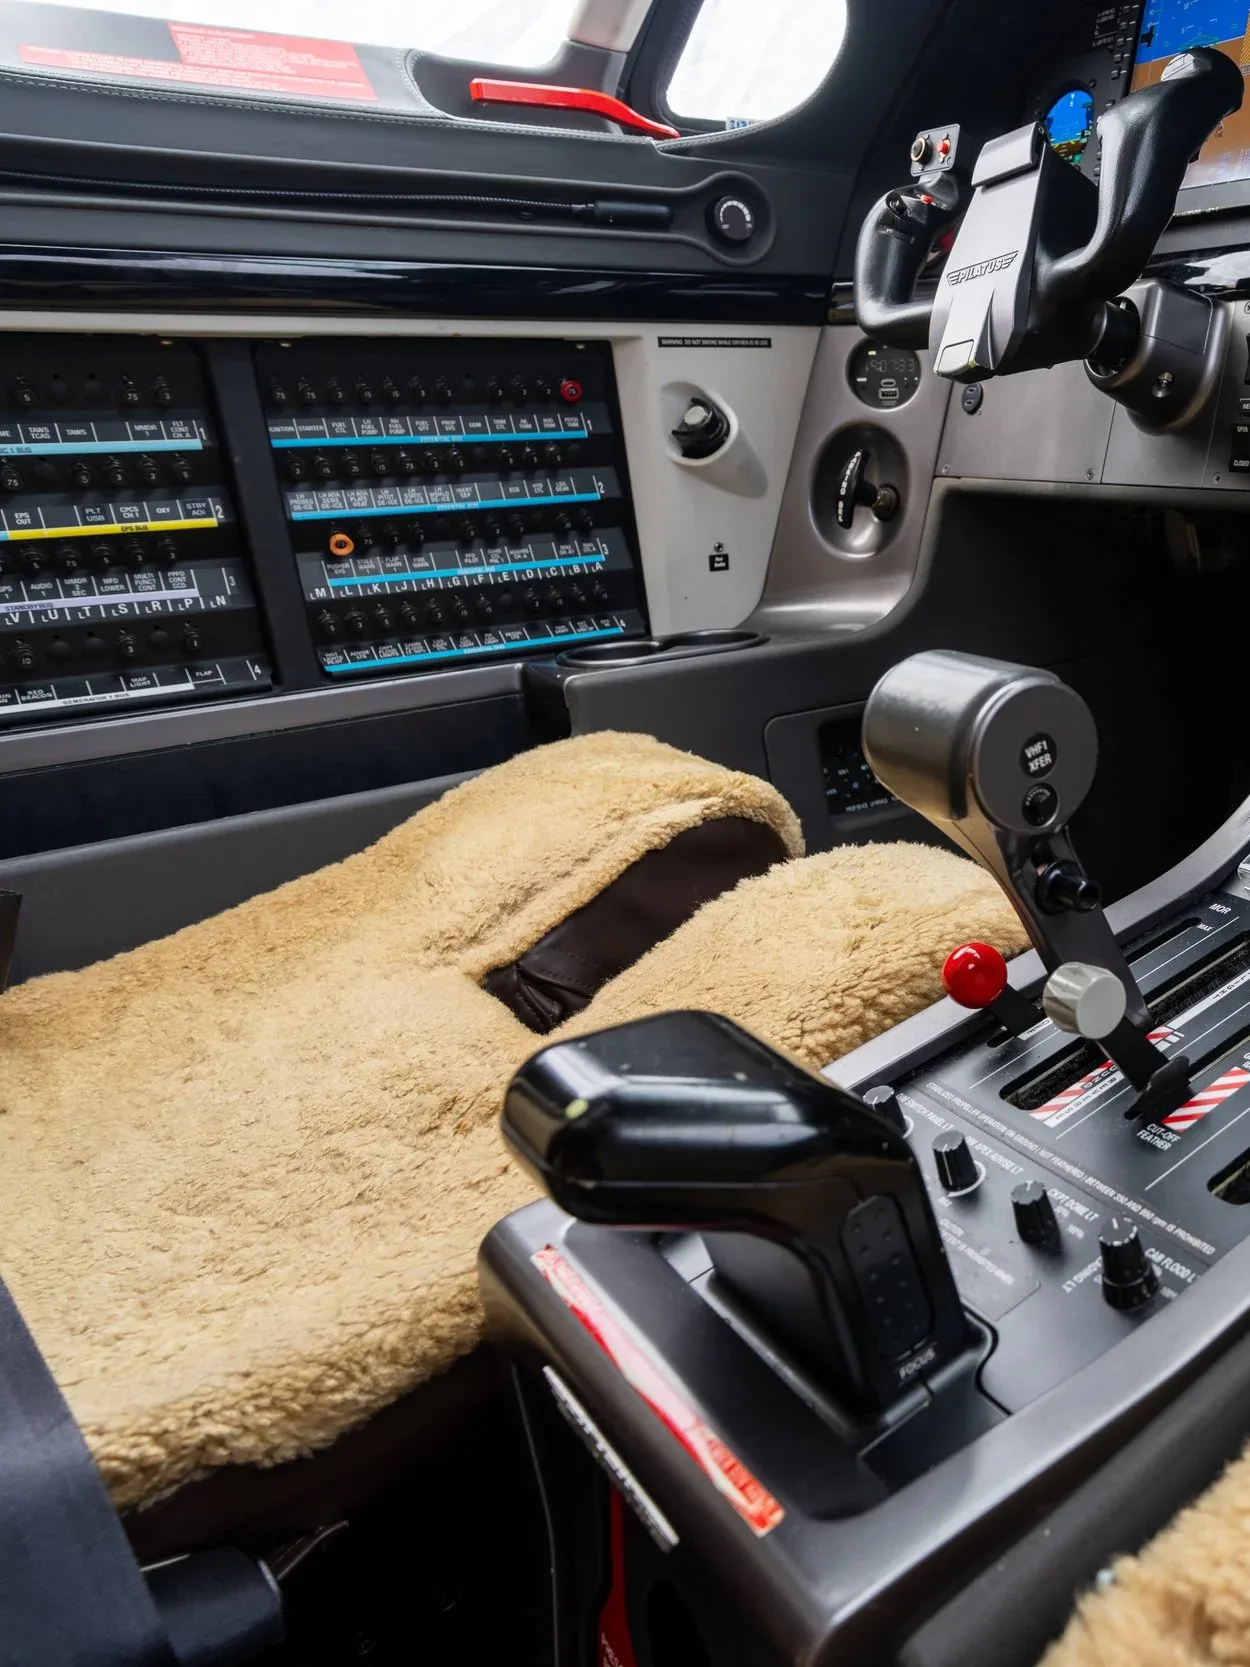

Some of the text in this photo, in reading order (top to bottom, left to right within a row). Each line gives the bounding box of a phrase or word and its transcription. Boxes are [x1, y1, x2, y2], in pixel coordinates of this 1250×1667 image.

[958, 259, 1004, 283] PILATUS
[85, 507, 101, 515] PLT
[215, 506, 225, 519] 2
[16, 517, 31, 525] OUT
[101, 583, 125, 592] LOWER
[1025, 740, 1048, 758] VHF1
[1028, 753, 1052, 773] XFER
[1209, 903, 1232, 915] MOR
[1197, 923, 1213, 932] MAX
[1136, 1130, 1172, 1151] FEATHER
[1146, 1122, 1180, 1144] CUT-OFF
[1048, 1188, 1089, 1215] CKPT DOME
[1144, 1248, 1187, 1279] CAB FLOOD
[899, 1348, 936, 1379] FOCUS
